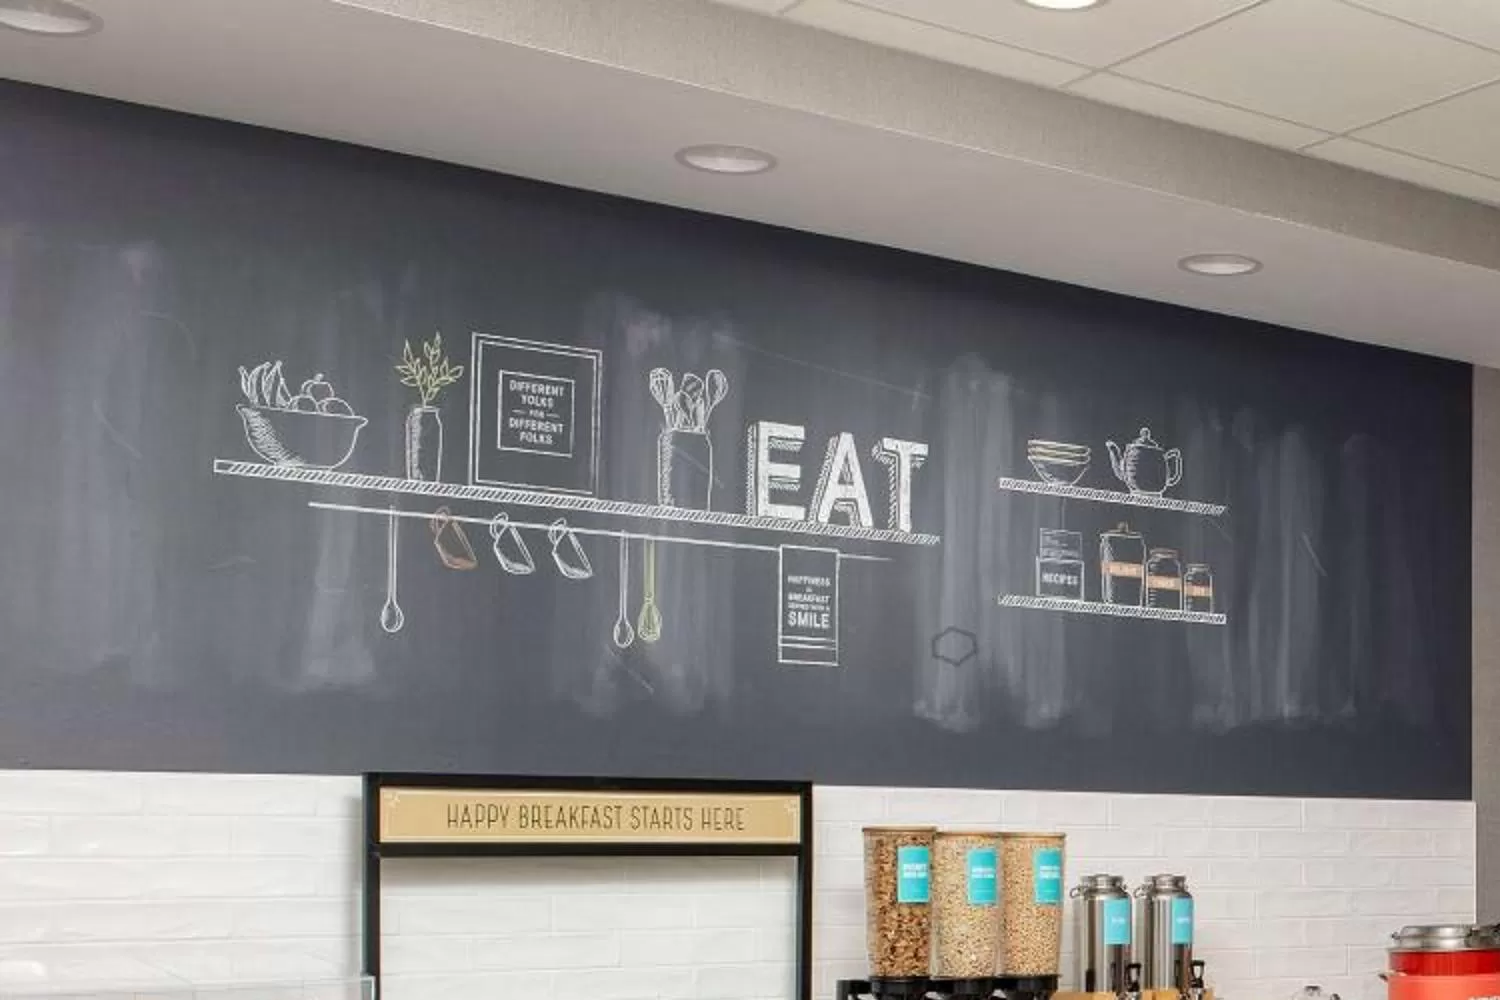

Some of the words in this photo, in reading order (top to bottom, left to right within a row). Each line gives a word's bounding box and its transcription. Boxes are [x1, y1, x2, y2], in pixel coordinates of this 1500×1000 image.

[509, 379, 564, 397] DIFFERENT
[521, 395, 554, 409] YOLKS
[509, 417, 564, 433] DIFFERENT
[519, 431, 553, 445] FOLKS
[747, 421, 928, 533] EAT
[787, 611, 830, 629] SMILE
[447, 803, 510, 829] HAPPY
[519, 804, 622, 830] BREAKFAST
[631, 805, 693, 831] STARTS
[701, 807, 745, 831] HERE
